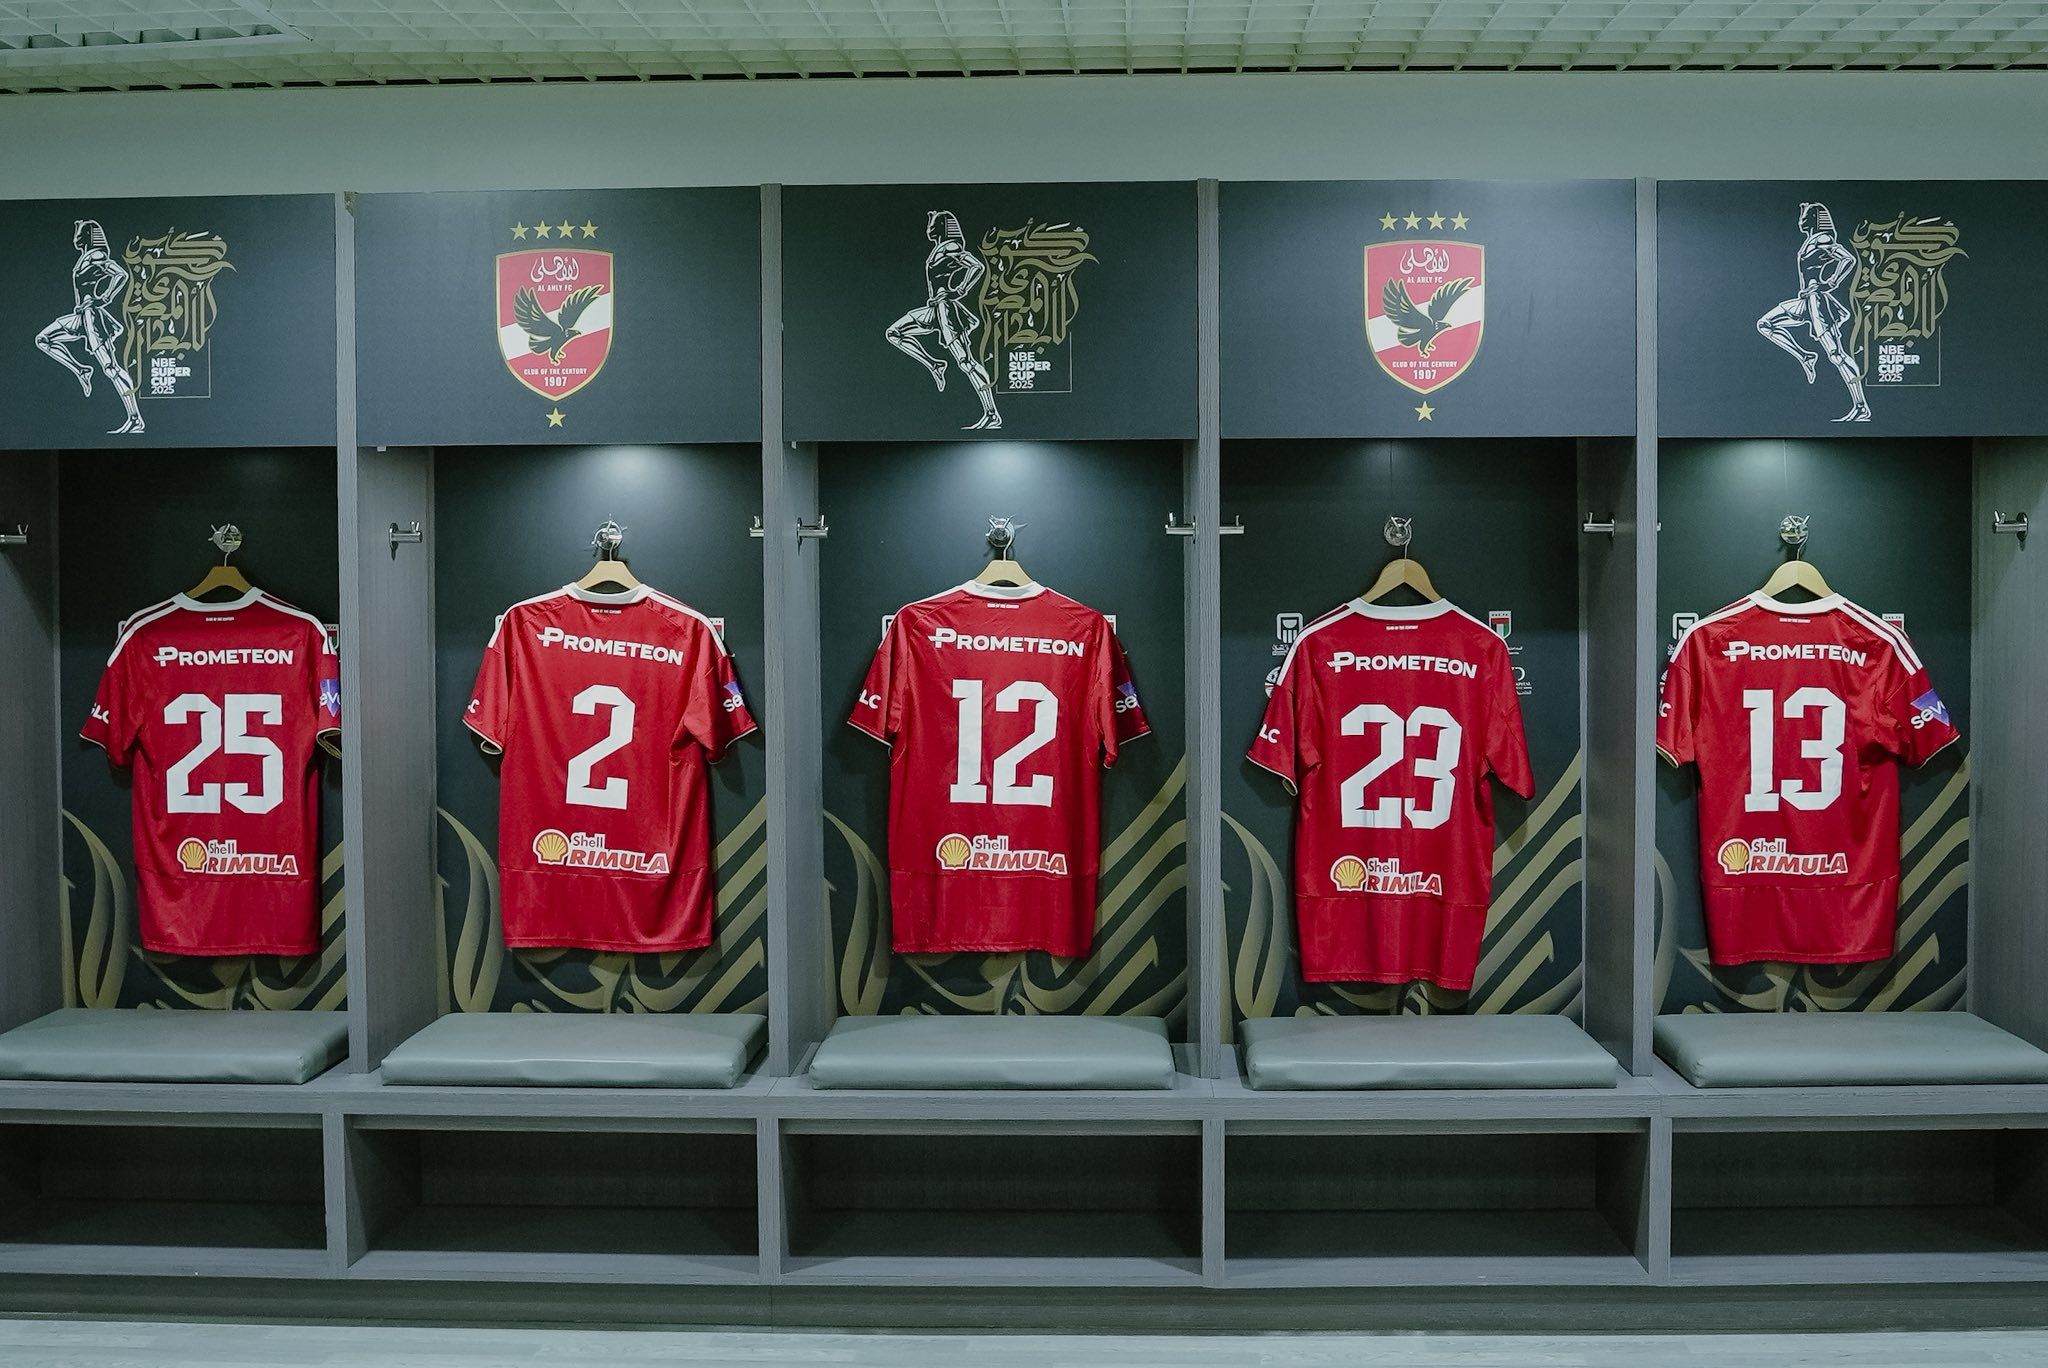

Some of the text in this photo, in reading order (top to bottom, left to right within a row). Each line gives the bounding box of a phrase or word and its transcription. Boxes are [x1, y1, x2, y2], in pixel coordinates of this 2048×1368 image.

[1879, 345, 1905, 354] NBE
[151, 358, 176, 367] NBE
[1009, 352, 1035, 361] NBE
[1878, 355, 1920, 365] SUPER
[151, 367, 191, 377] SUPER
[1009, 361, 1051, 371] SUPER
[1878, 364, 1904, 374] CUP
[151, 376, 176, 386] CUP
[1009, 371, 1035, 381] CUP
[1413, 369, 1437, 380] 1907
[1879, 373, 1903, 382] 2025
[544, 376, 567, 387] 1907
[1009, 380, 1034, 389] 2025
[151, 386, 175, 394] 2025
[537, 627, 684, 666] PROMETEON
[928, 627, 1084, 657] PROMETEON
[153, 647, 293, 667] PROMETEON
[1722, 640, 1866, 667] PROMETEON
[1327, 651, 1477, 678] PROMETEON
[723, 694, 744, 713] se
[1115, 695, 1137, 713] se
[566, 684, 635, 810] 2
[949, 679, 1058, 807] 12
[1743, 687, 1846, 812] 13
[164, 693, 283, 814] 25
[1341, 703, 1462, 829] 23
[573, 835, 603, 847] Shell
[975, 838, 1007, 850] Shell
[1753, 841, 1784, 853] Shell
[209, 842, 235, 855] Shell
[208, 857, 296, 873] RIMULA
[569, 849, 667, 871] RIMULA
[972, 852, 1064, 872] RIMULA
[1368, 860, 1397, 873] Shell
[1751, 855, 1846, 872] RIMULA
